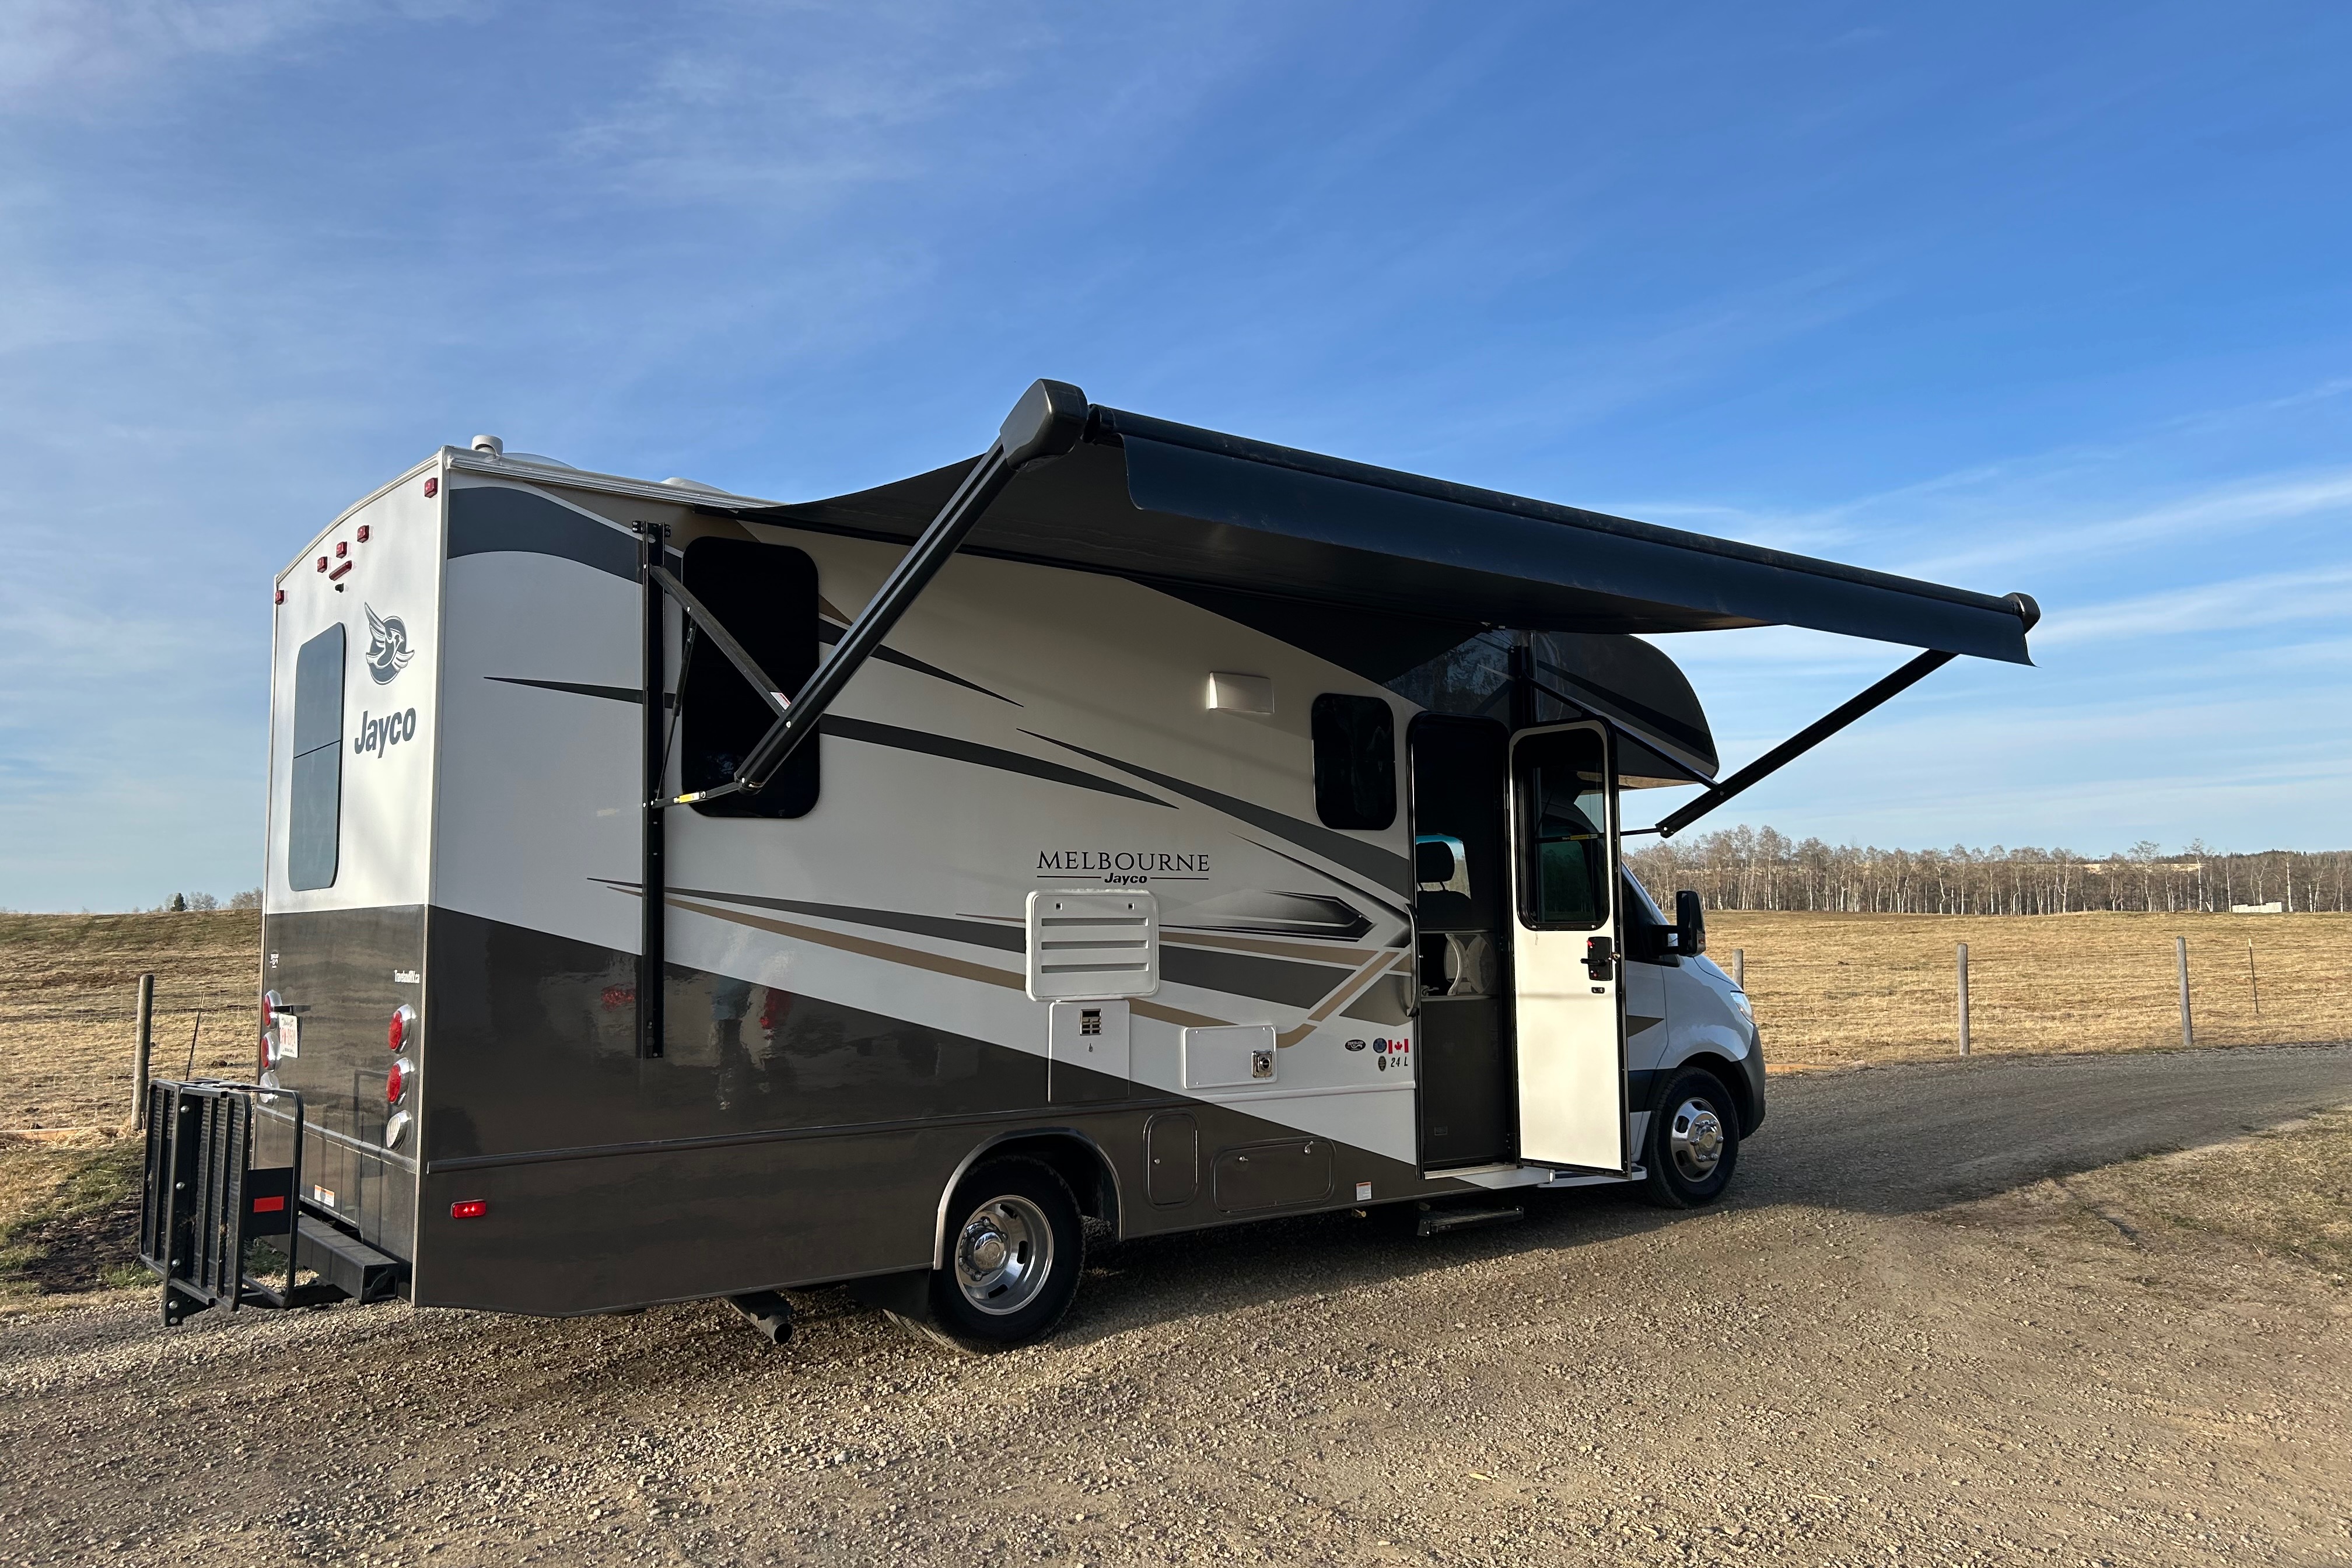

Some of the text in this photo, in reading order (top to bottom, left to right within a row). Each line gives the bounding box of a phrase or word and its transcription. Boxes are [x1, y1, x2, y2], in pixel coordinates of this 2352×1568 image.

[355, 707, 416, 758] Jayco
[1037, 850, 1210, 872] MELBOURNE
[1104, 873, 1147, 886] Jayco
